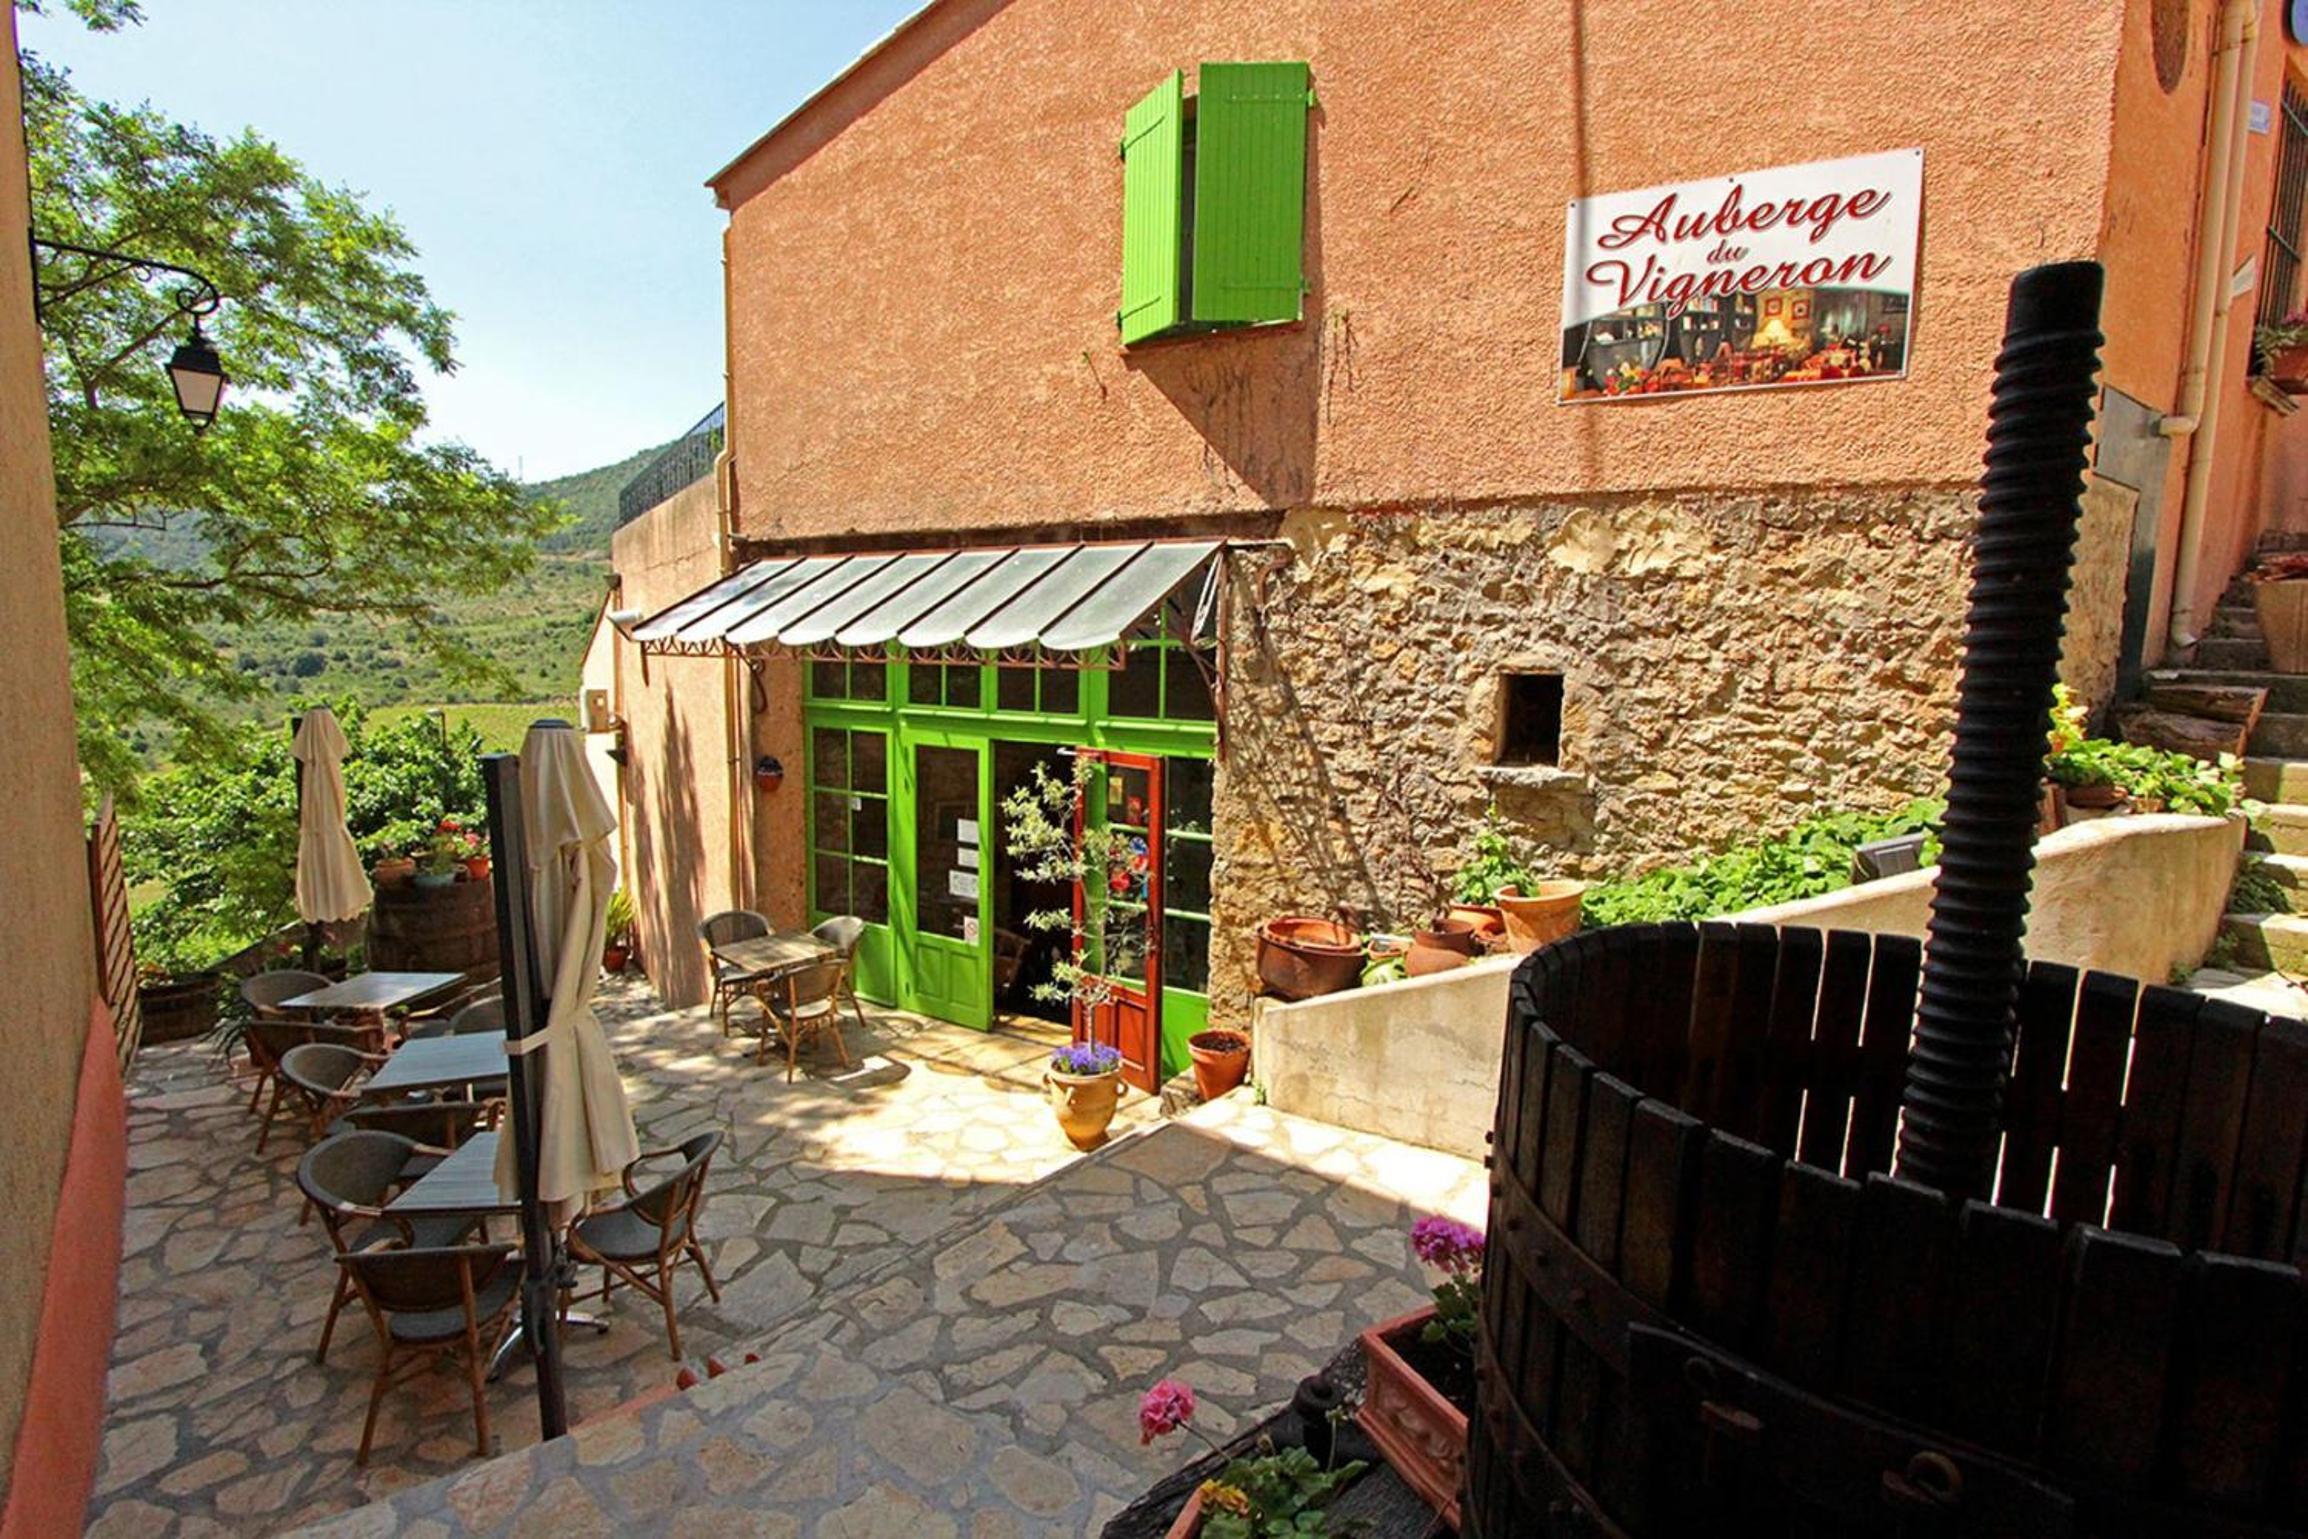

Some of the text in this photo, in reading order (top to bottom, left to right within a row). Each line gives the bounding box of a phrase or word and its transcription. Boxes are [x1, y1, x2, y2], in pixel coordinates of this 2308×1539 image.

[1598, 184, 1892, 250] Auberge
[1586, 250, 1893, 318] Vigneron
[1706, 239, 1749, 265] du
